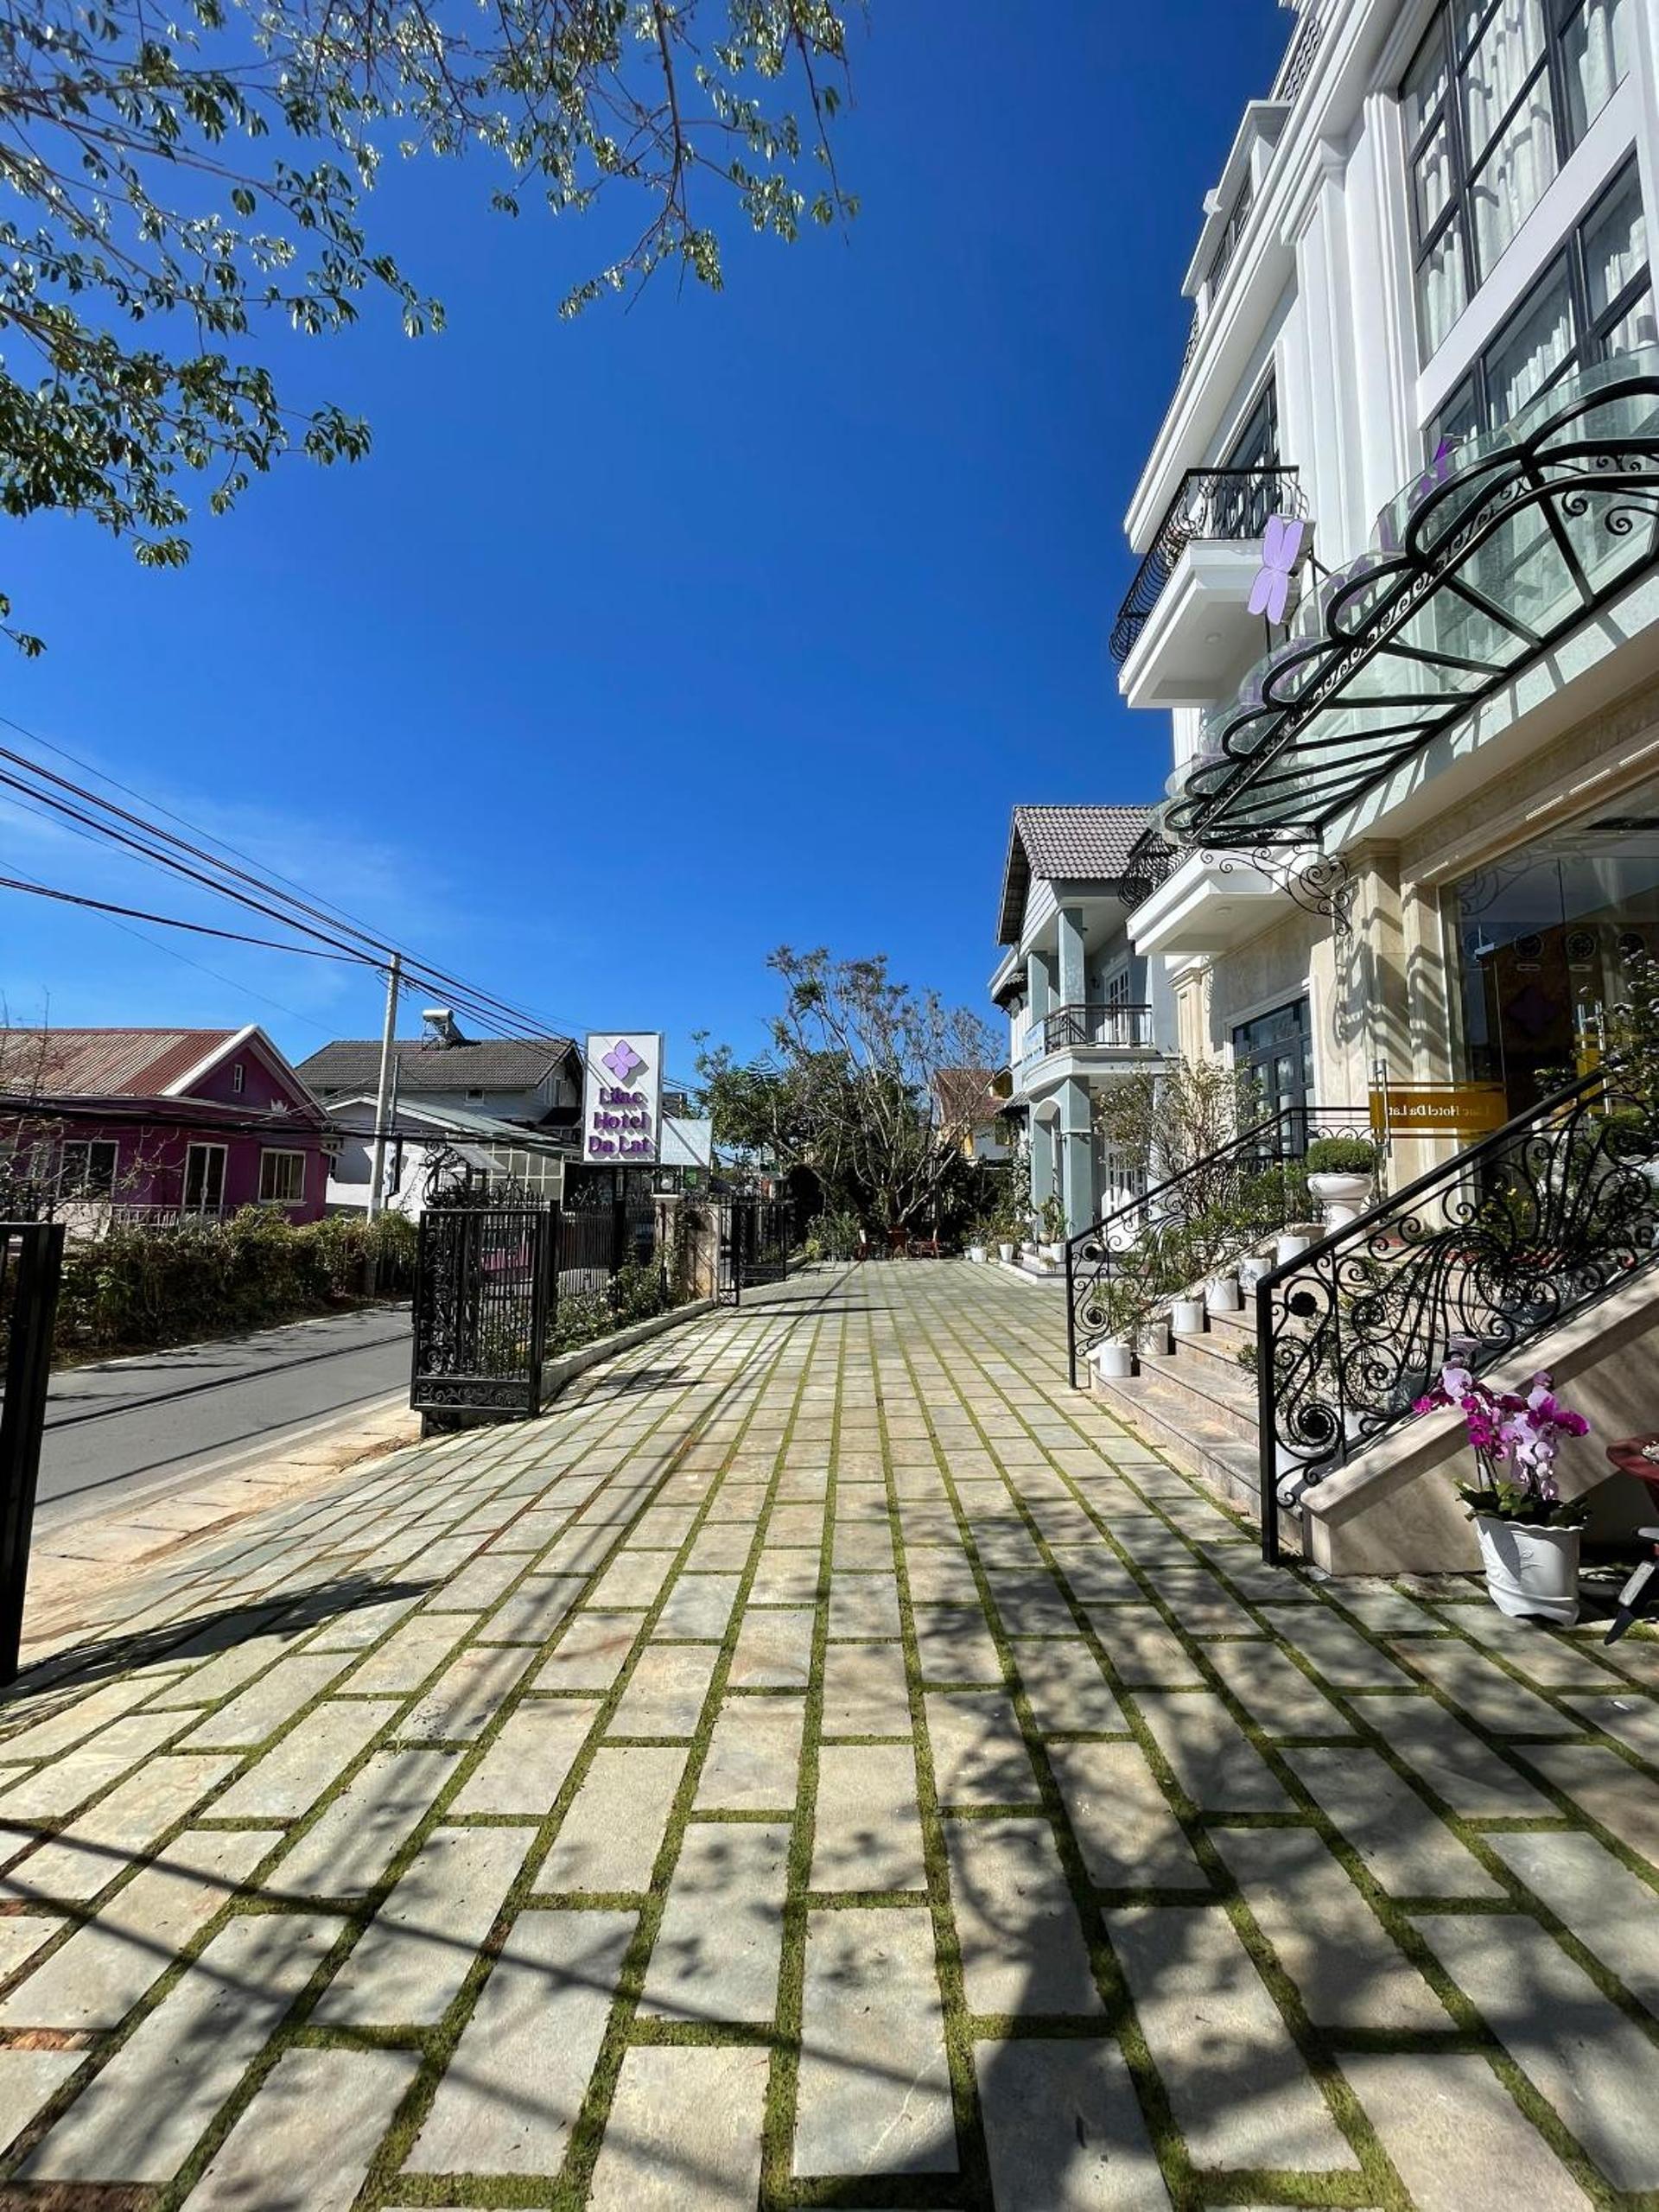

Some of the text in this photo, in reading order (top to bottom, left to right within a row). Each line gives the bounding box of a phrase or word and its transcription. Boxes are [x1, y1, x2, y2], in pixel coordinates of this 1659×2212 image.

[599, 1086, 644, 1104] Lilac
[594, 1111, 645, 1129] Hotel
[588, 1135, 650, 1153] Da Lat
